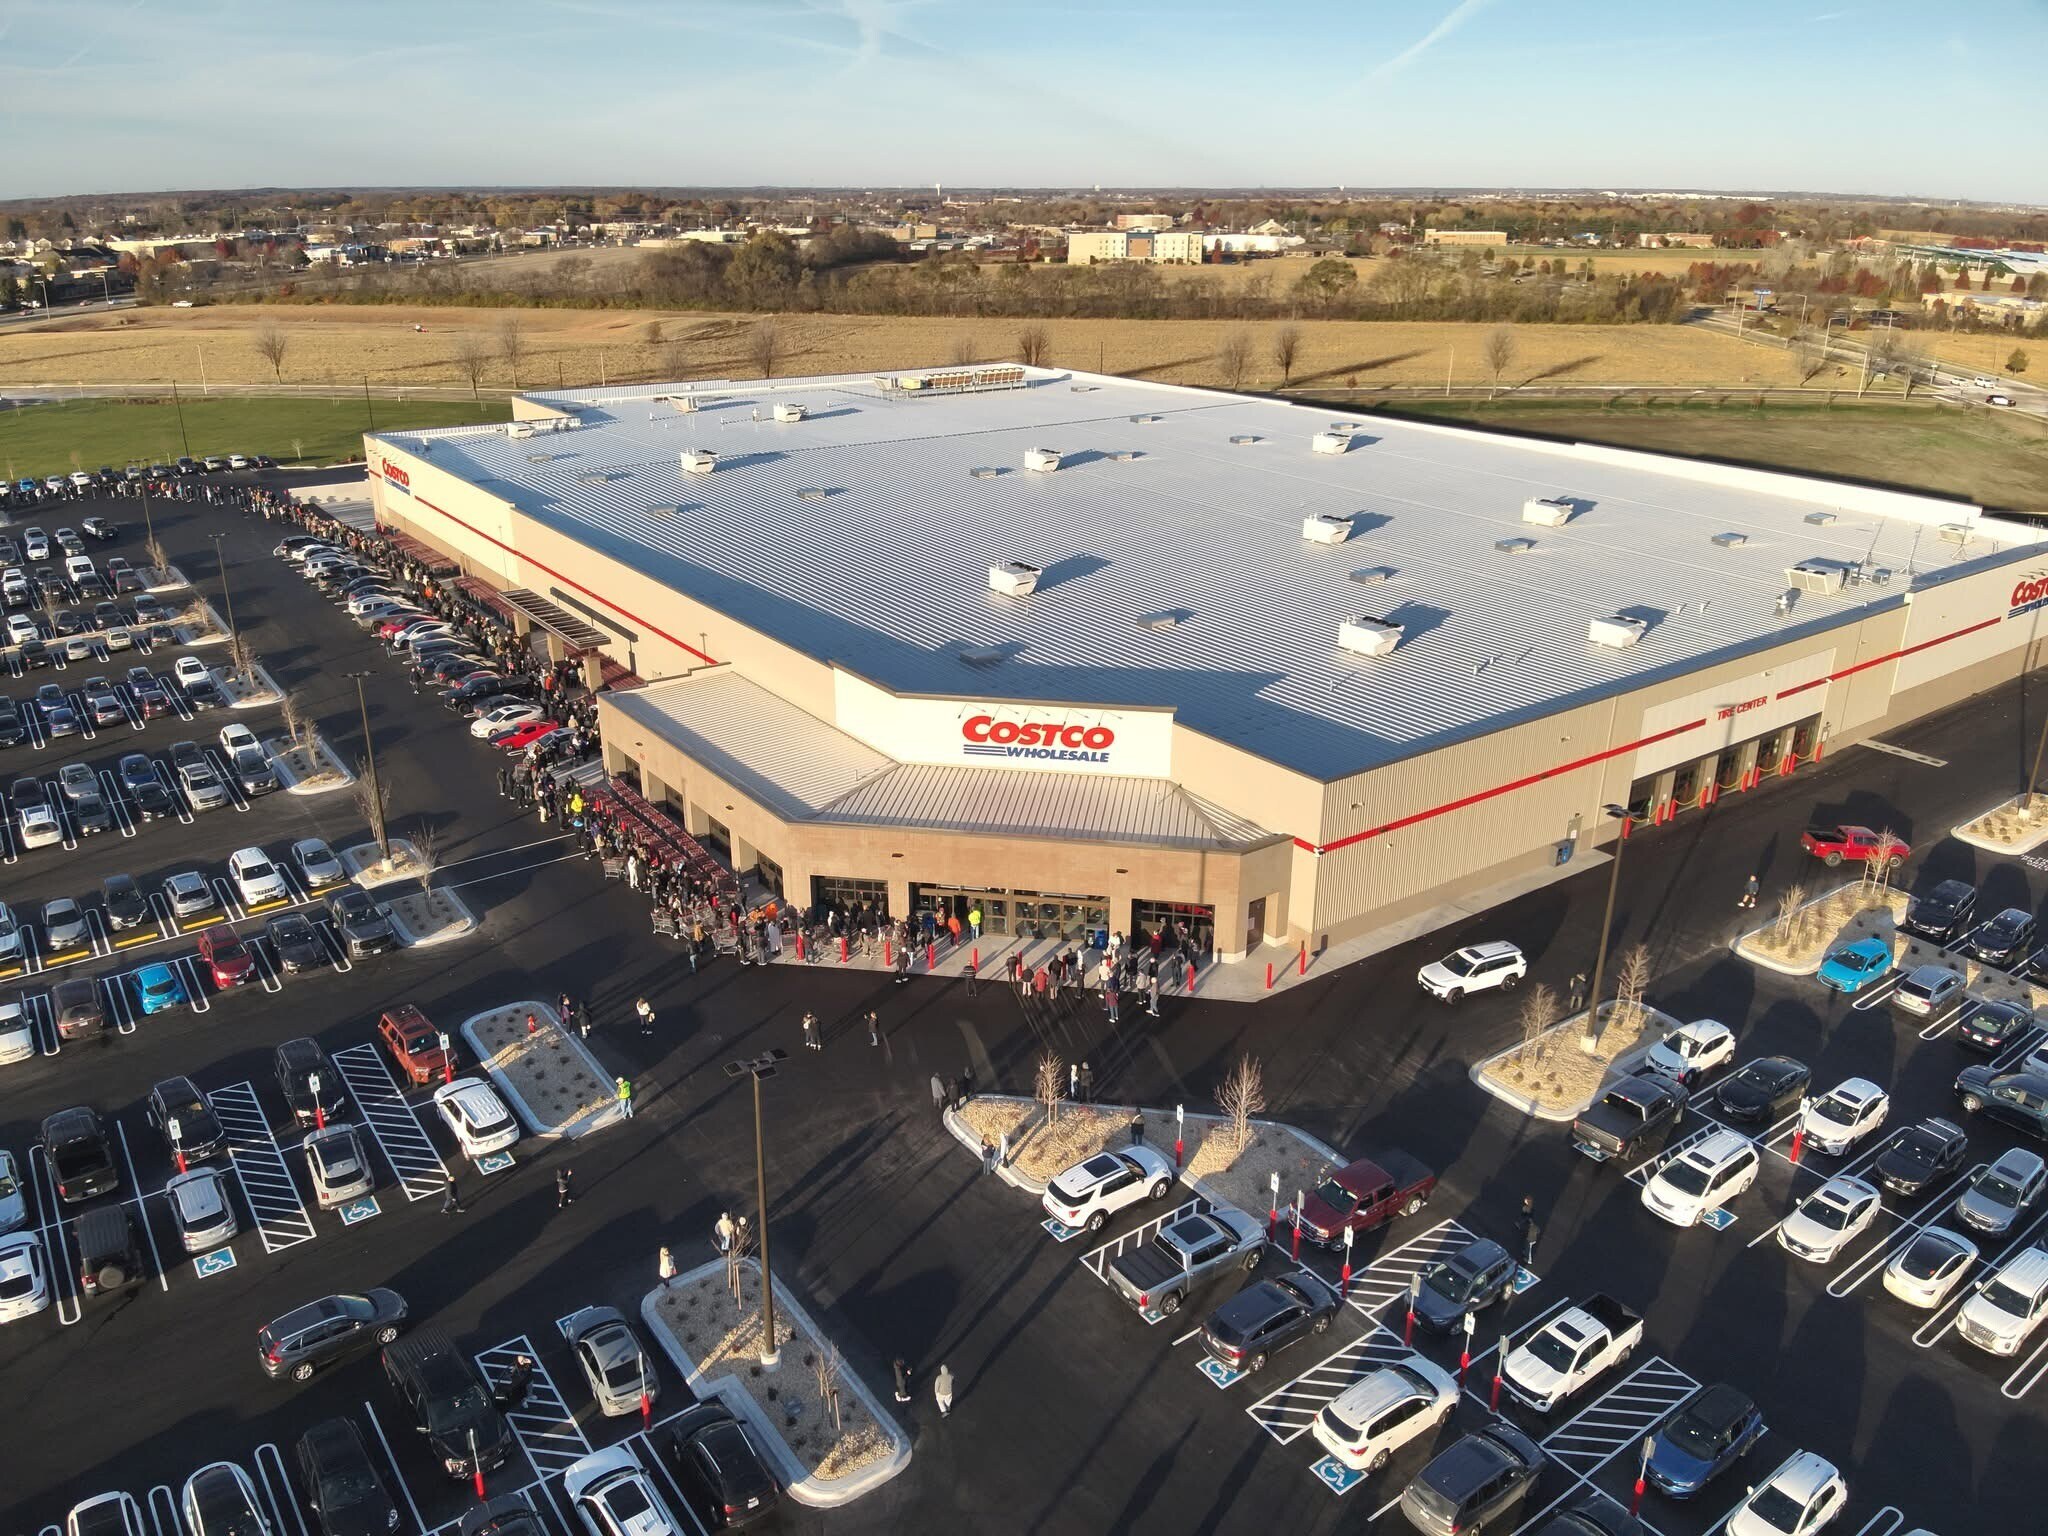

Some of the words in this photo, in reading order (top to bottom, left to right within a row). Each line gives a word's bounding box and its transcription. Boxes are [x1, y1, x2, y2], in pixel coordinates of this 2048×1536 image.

[2011, 577, 2048, 607] COST
[1717, 706, 1735, 721] TIRE
[1736, 696, 1768, 714] CENTER
[962, 715, 1115, 750] COSTCO
[1006, 747, 1110, 763] WHOLESALE
